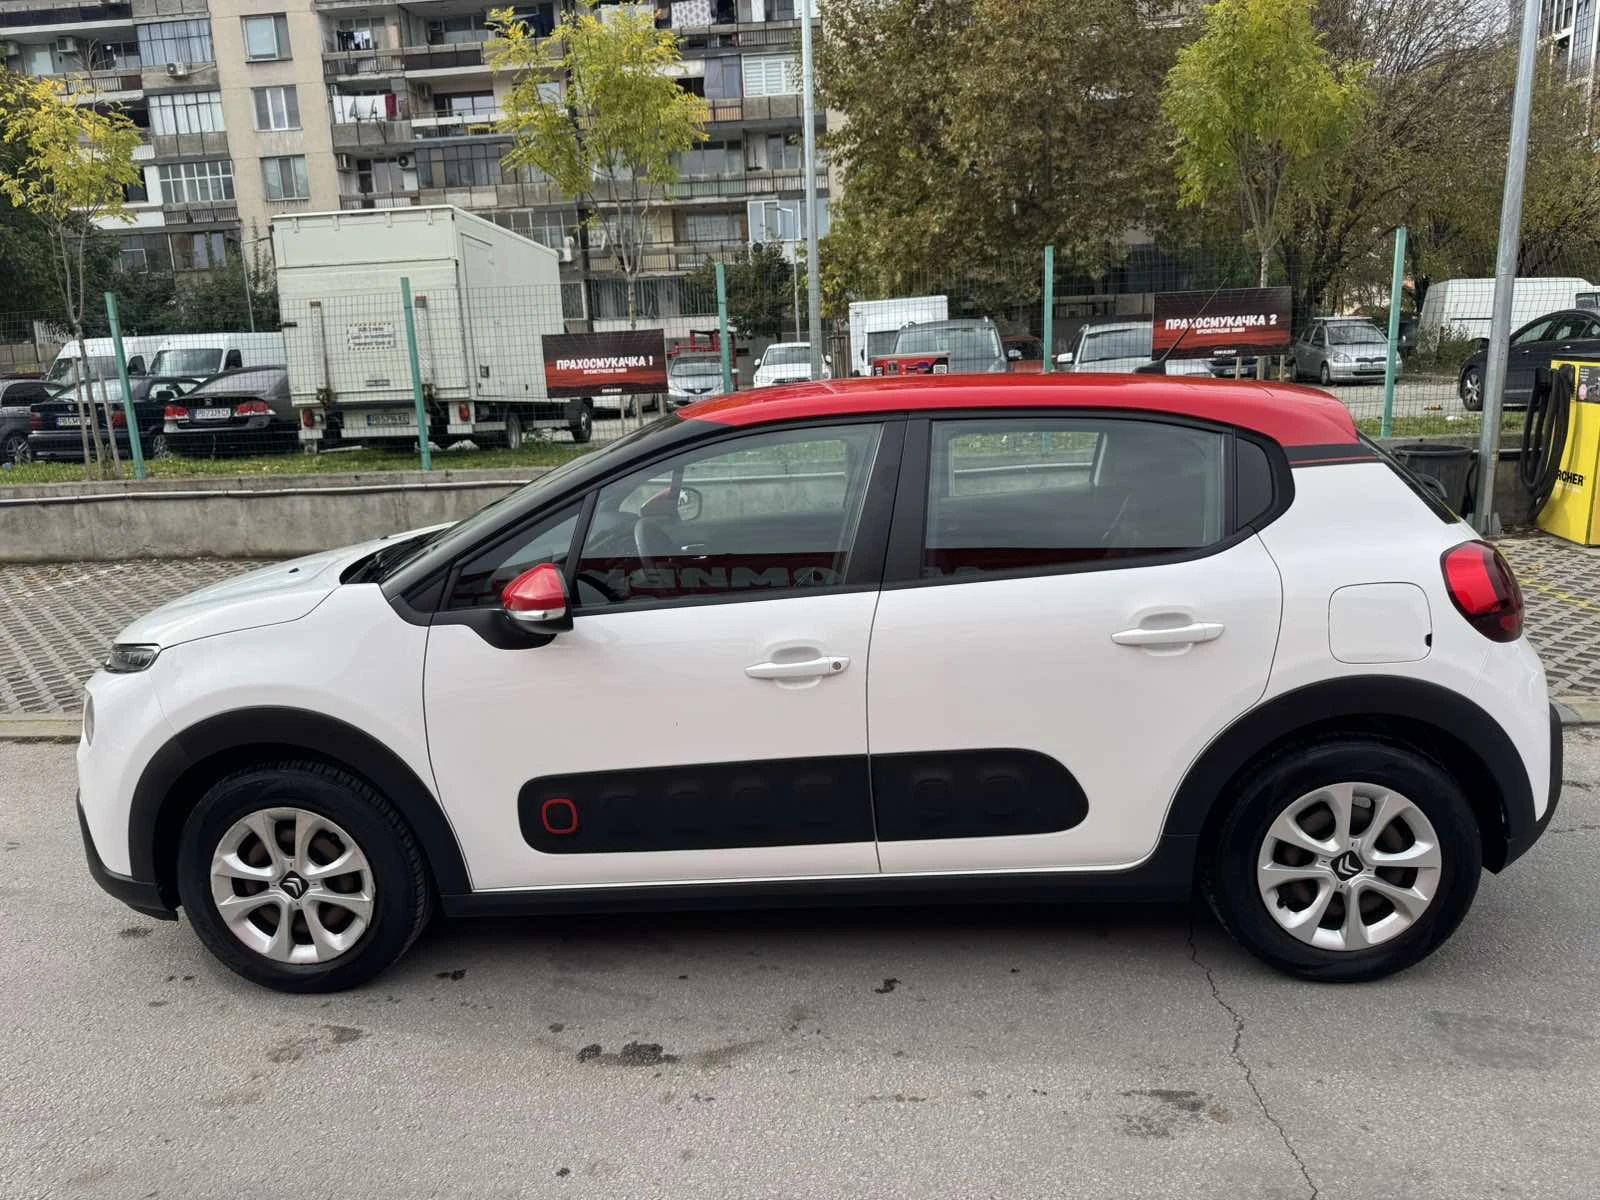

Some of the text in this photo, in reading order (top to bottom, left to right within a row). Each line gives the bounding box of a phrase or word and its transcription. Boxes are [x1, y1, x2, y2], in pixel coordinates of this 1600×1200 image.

[1269, 314, 1278, 325] 2
[556, 356, 646, 370] ПРАХОСМУКАЧКА
[1555, 470, 1584, 486] RCHER
